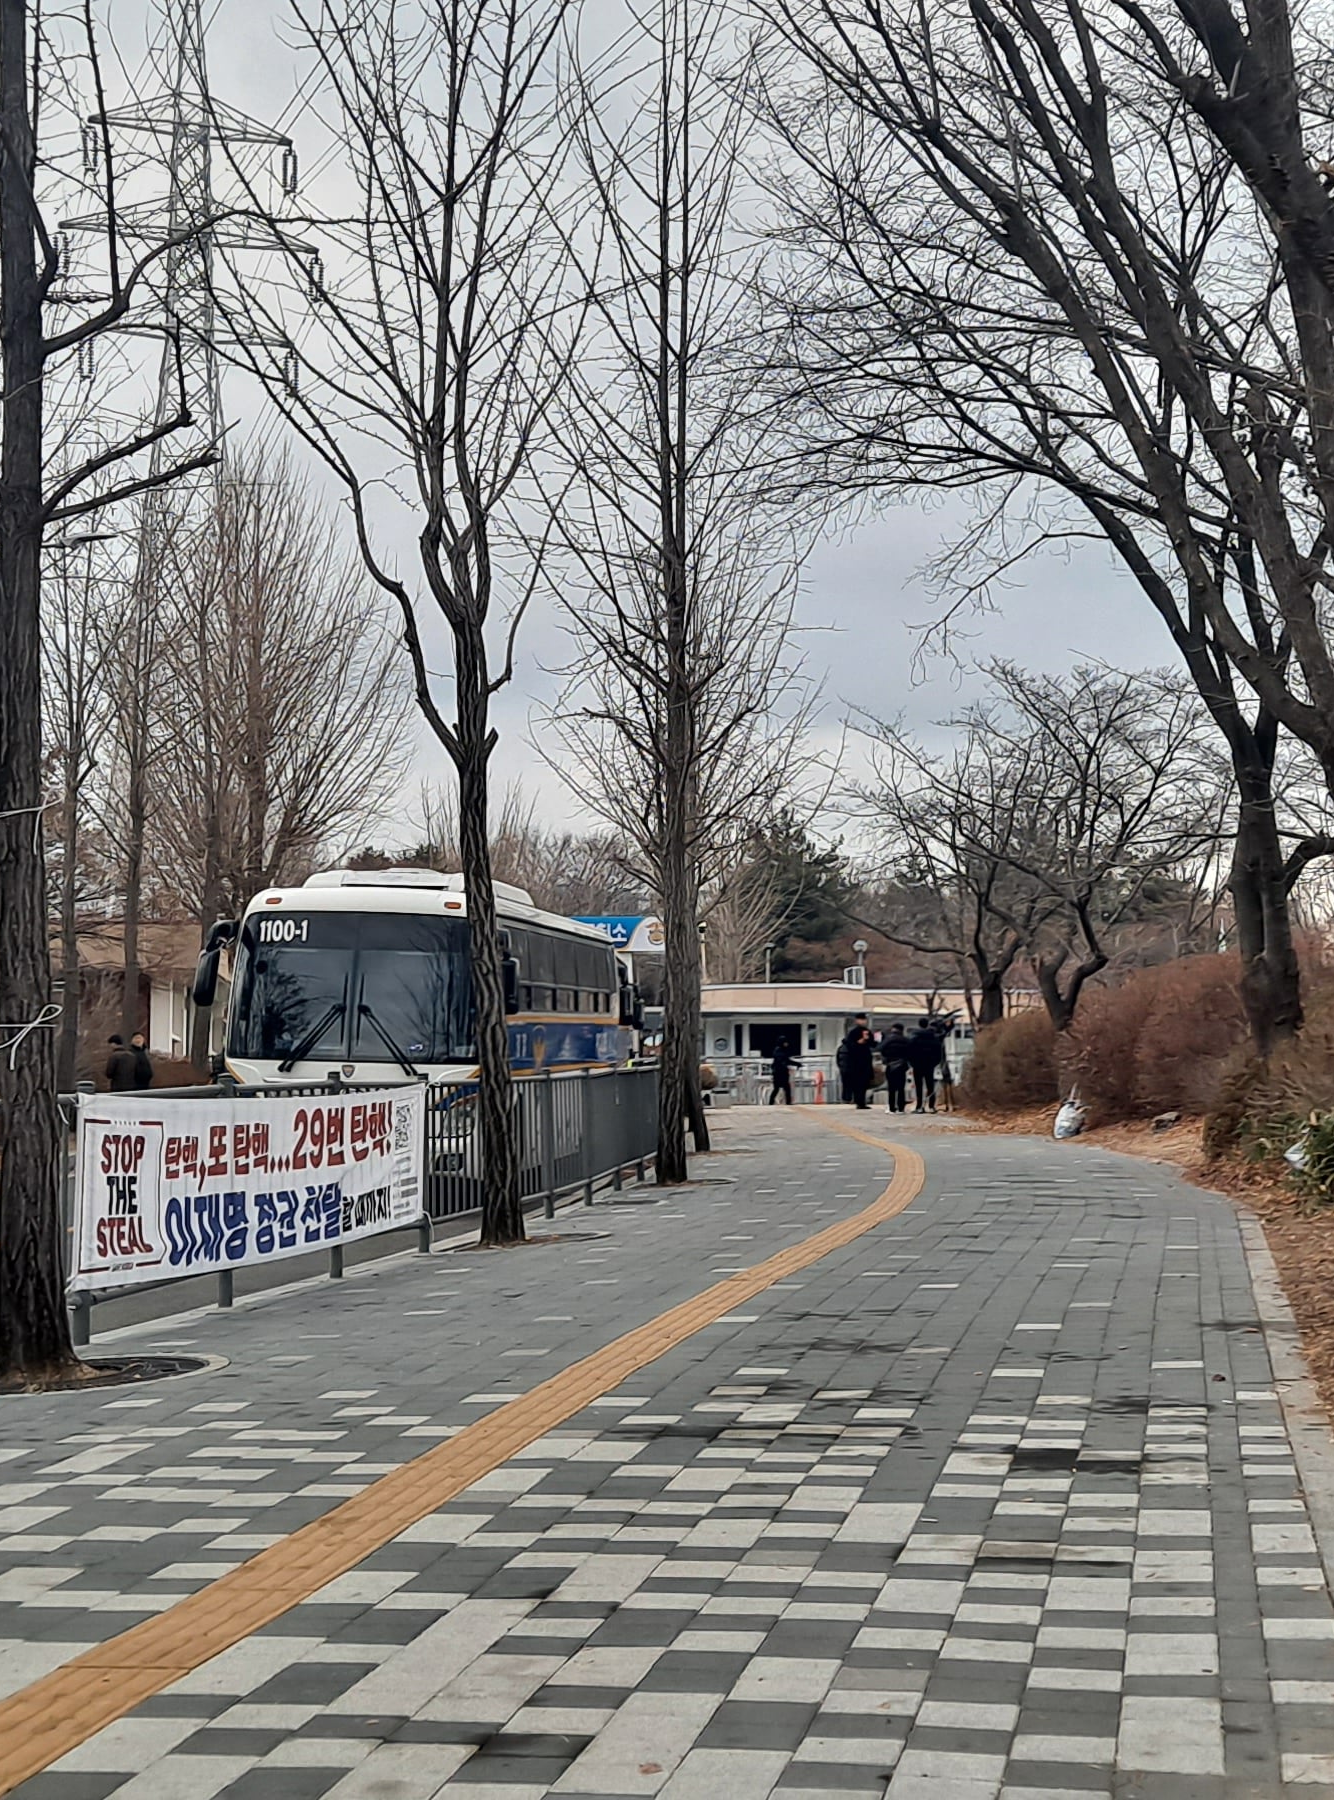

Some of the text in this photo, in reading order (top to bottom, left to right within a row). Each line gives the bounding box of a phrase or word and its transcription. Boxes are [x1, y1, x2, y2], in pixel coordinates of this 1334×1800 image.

[259, 919, 309, 942] 1100-1
[350, 1100, 393, 1162] 탄핵!
[101, 1134, 145, 1174] STOP
[106, 1175, 138, 1215] THE
[97, 1216, 154, 1258] STEAL
[165, 1190, 249, 1267] 이재명
